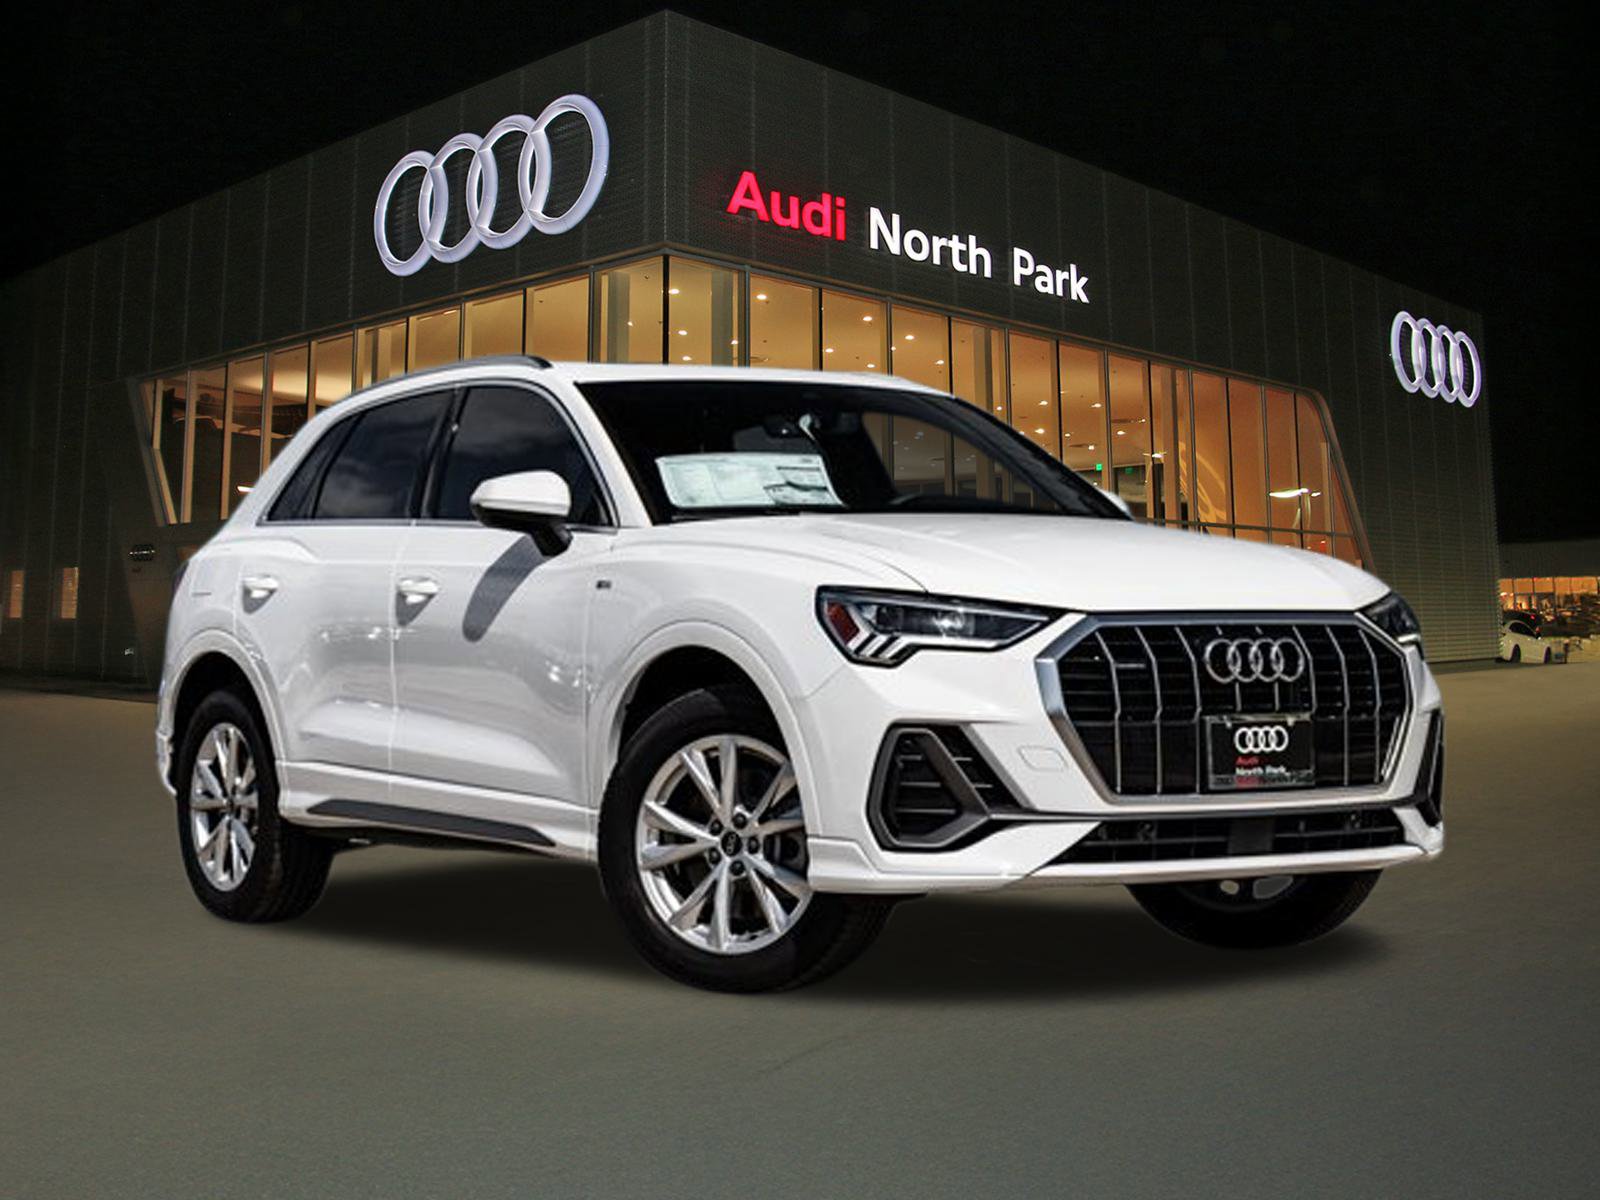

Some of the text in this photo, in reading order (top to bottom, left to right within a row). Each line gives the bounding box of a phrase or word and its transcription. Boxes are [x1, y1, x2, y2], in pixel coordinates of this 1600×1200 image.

[726, 171, 1090, 303] Audi North Park
